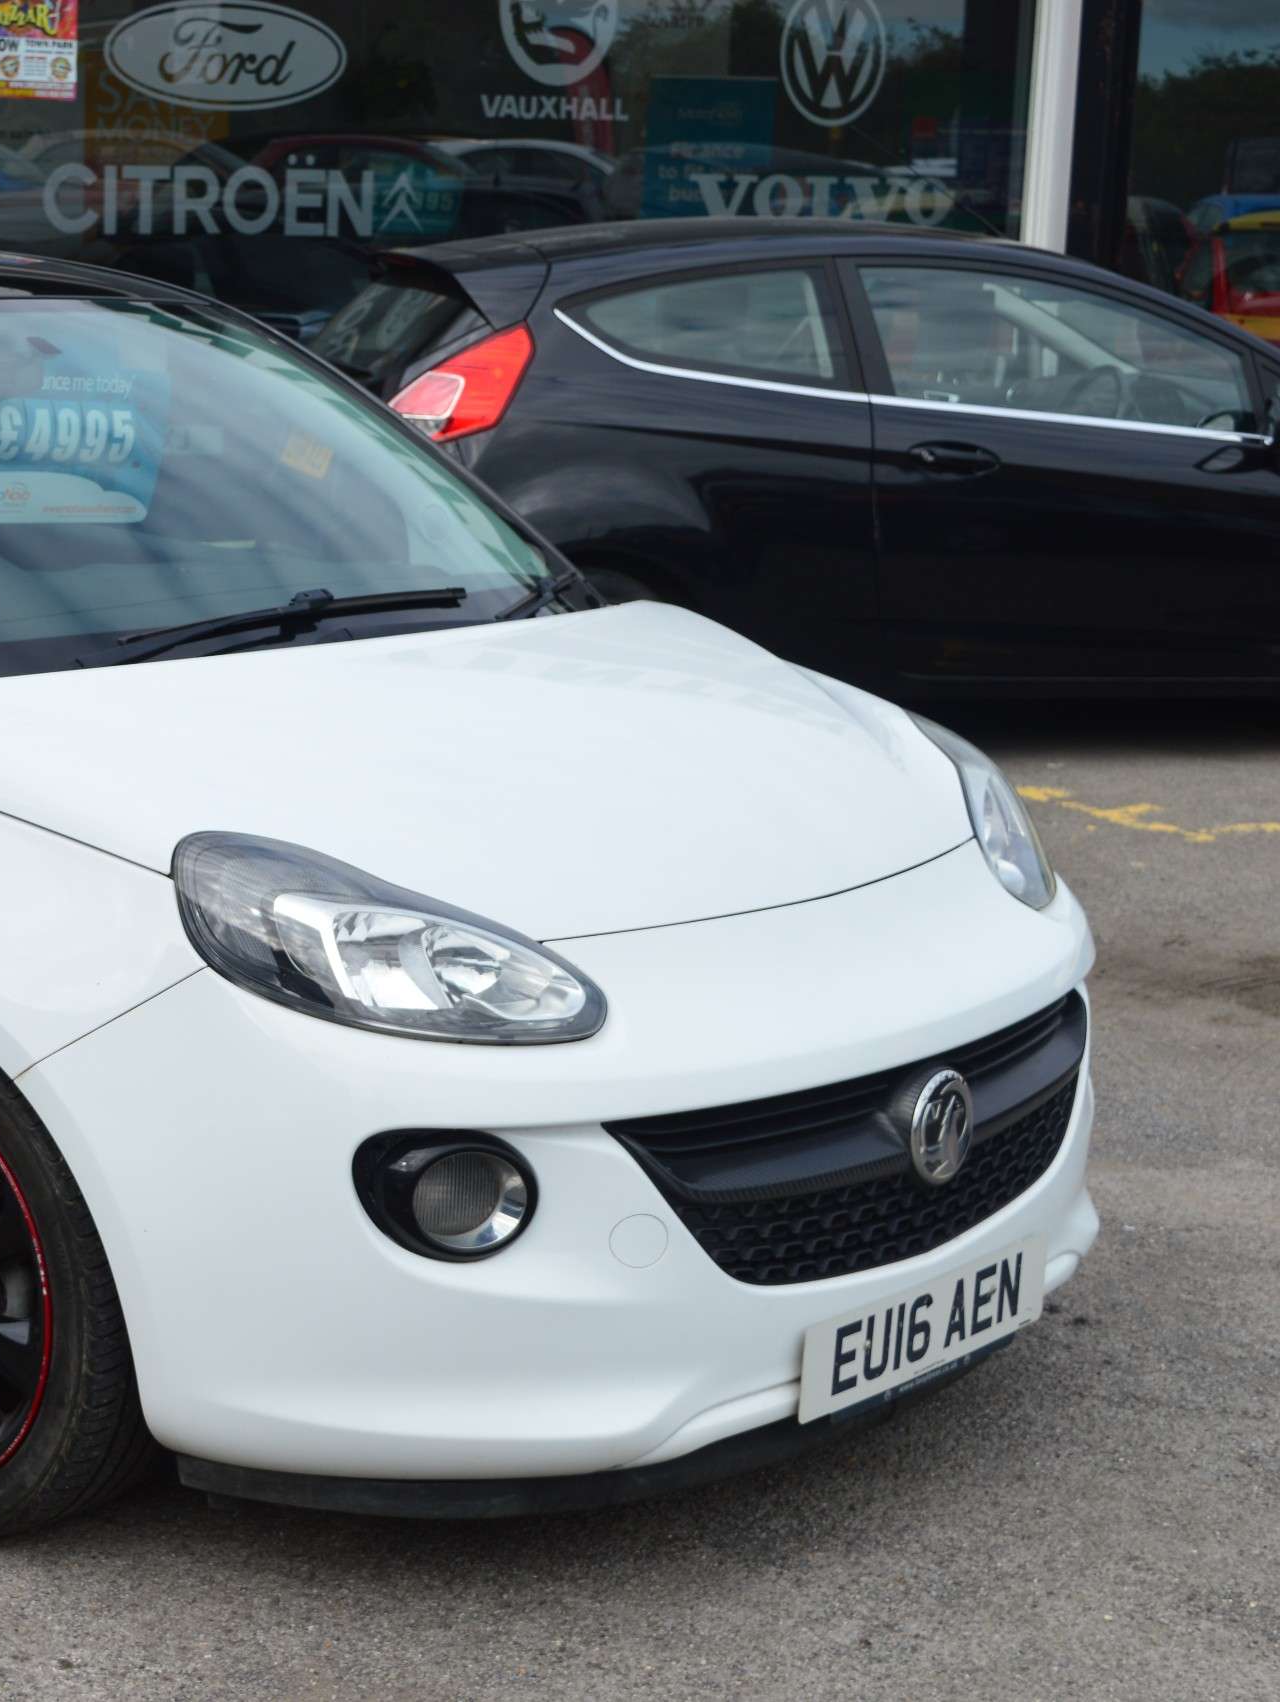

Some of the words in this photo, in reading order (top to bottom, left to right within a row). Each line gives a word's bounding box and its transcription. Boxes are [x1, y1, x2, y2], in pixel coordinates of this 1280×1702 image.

[158, 17, 297, 87] Ford
[480, 93, 628, 122] VAUXHALL
[42, 154, 374, 238] CITROËN
[689, 172, 955, 227] VOLVO
[831, 1293, 934, 1396] EU16
[943, 1252, 1022, 1349] AEN
